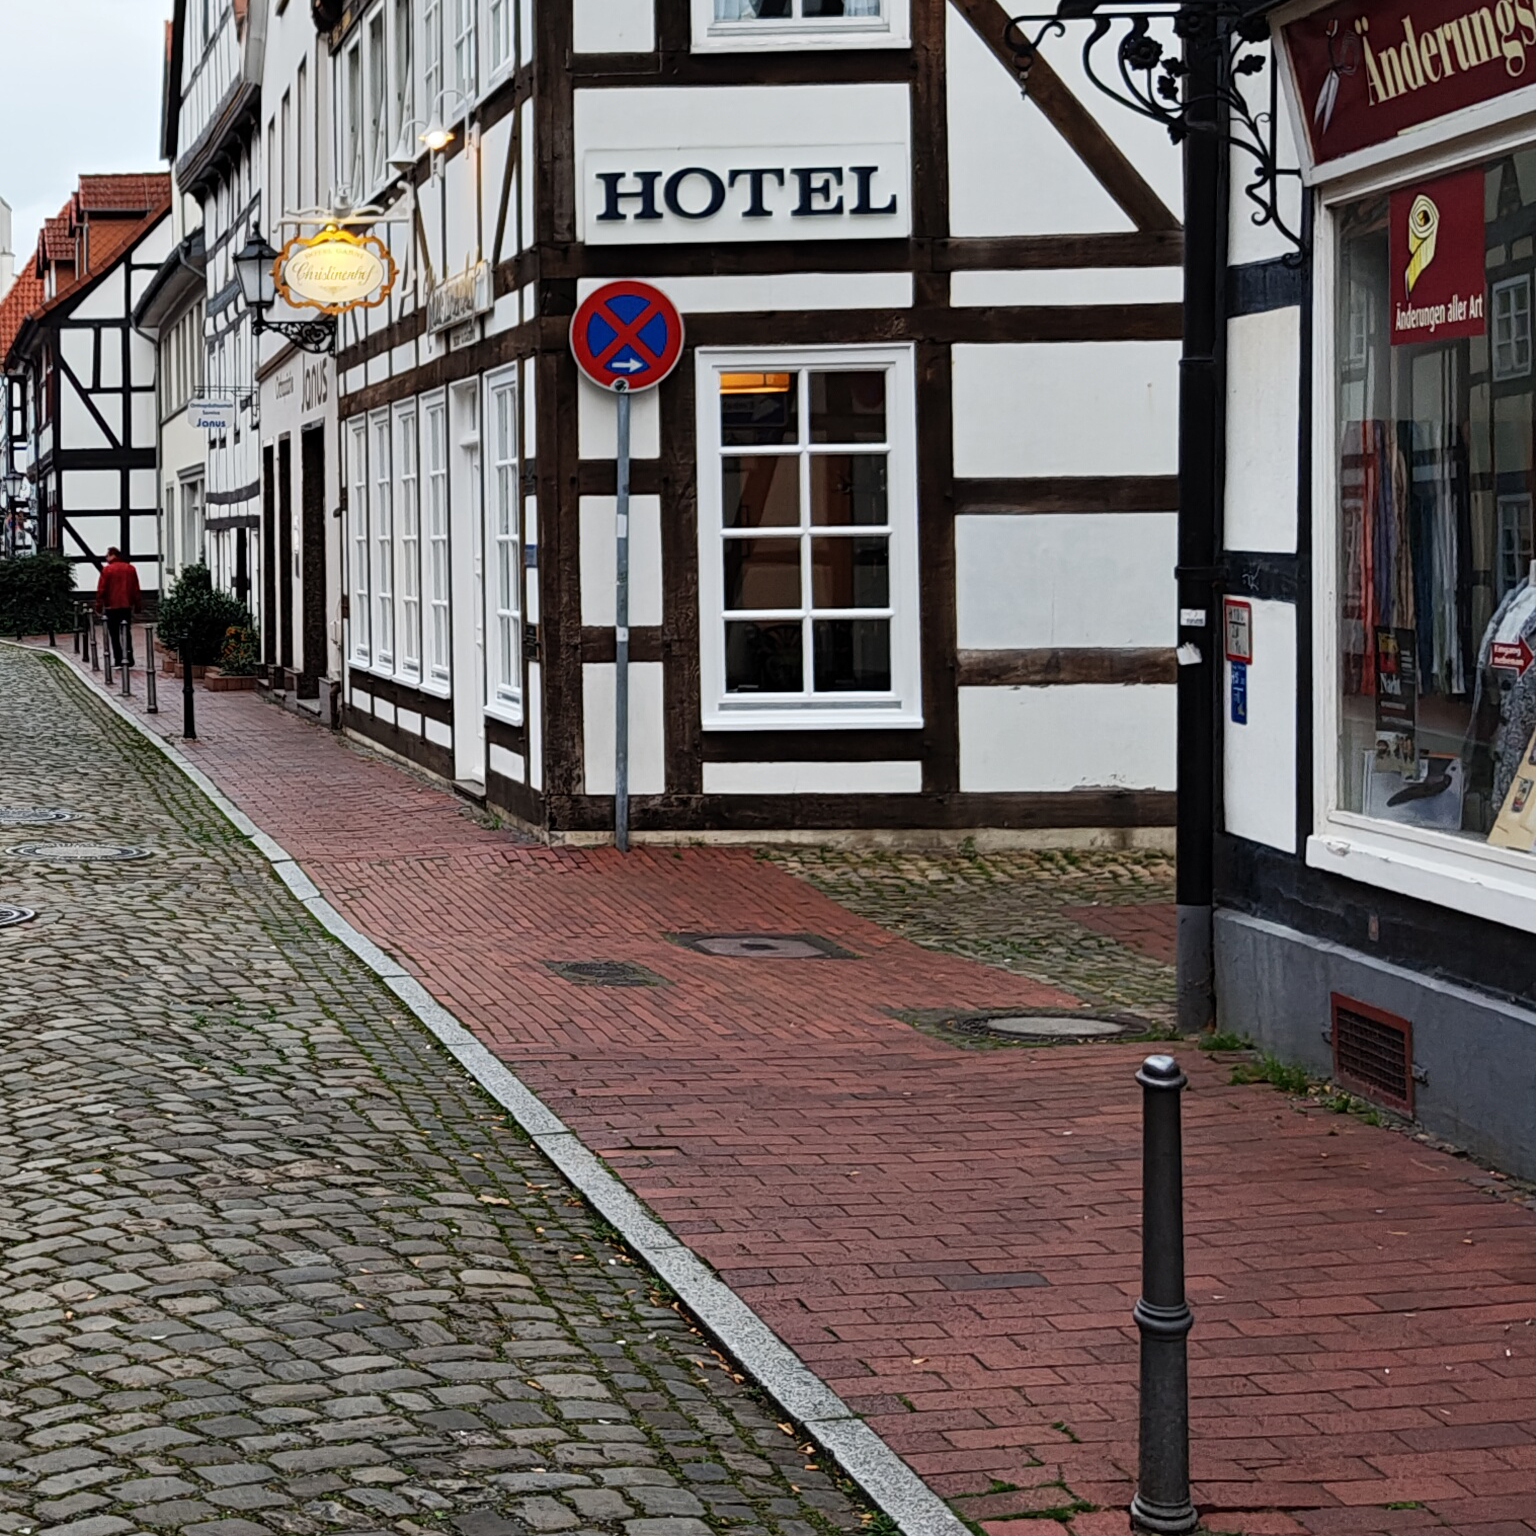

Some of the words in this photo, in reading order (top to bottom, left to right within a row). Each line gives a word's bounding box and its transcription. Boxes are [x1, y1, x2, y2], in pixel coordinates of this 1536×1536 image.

[595, 167, 898, 220] HOTEL
[1395, 302, 1446, 332] Änderungen
[1447, 294, 1468, 323] aller
[1469, 293, 1483, 319] Art
[301, 353, 328, 414] Janus
[196, 417, 226, 428] Janus
